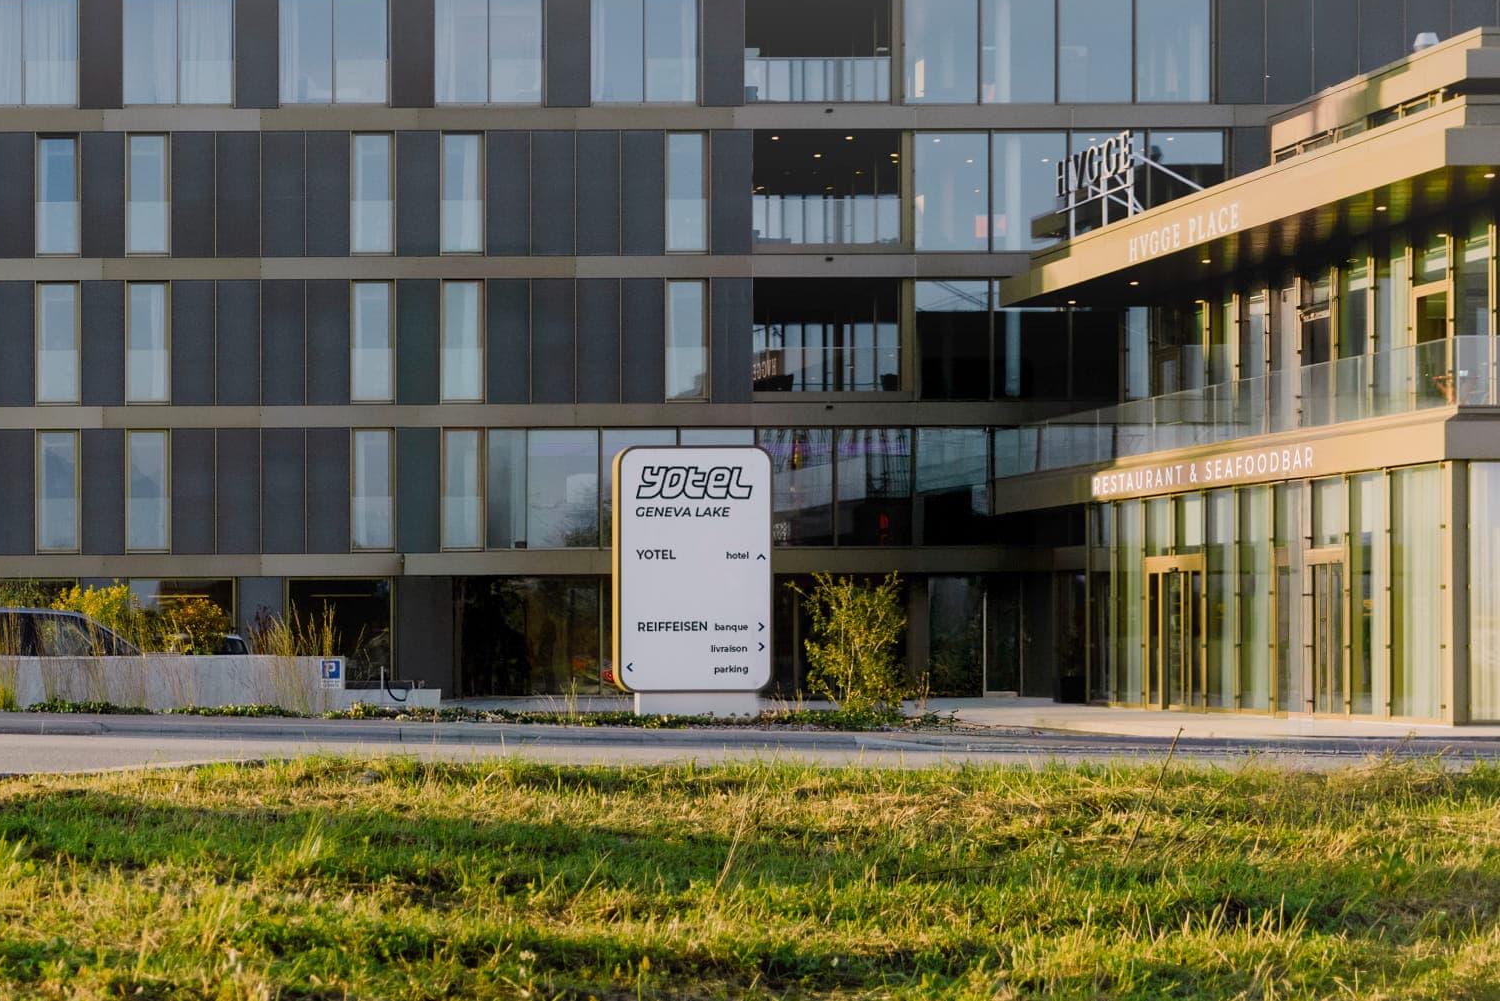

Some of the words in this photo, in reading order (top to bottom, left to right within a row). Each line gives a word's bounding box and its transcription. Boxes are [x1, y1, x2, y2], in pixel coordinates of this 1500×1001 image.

[1187, 202, 1239, 244] PLACE
[1092, 464, 1183, 497] RESTAURANT
[1189, 463, 1197, 482] &
[1205, 446, 1314, 482] SEAFOODBAR
[636, 506, 691, 518] GENEVA
[695, 506, 731, 518] LAKE
[636, 549, 676, 560] YOTEL
[726, 551, 749, 560] hotel
[637, 621, 708, 633] REIFFEISEN
[714, 623, 749, 633] banque
[710, 645, 748, 653] livraison
[714, 665, 749, 675] parking
